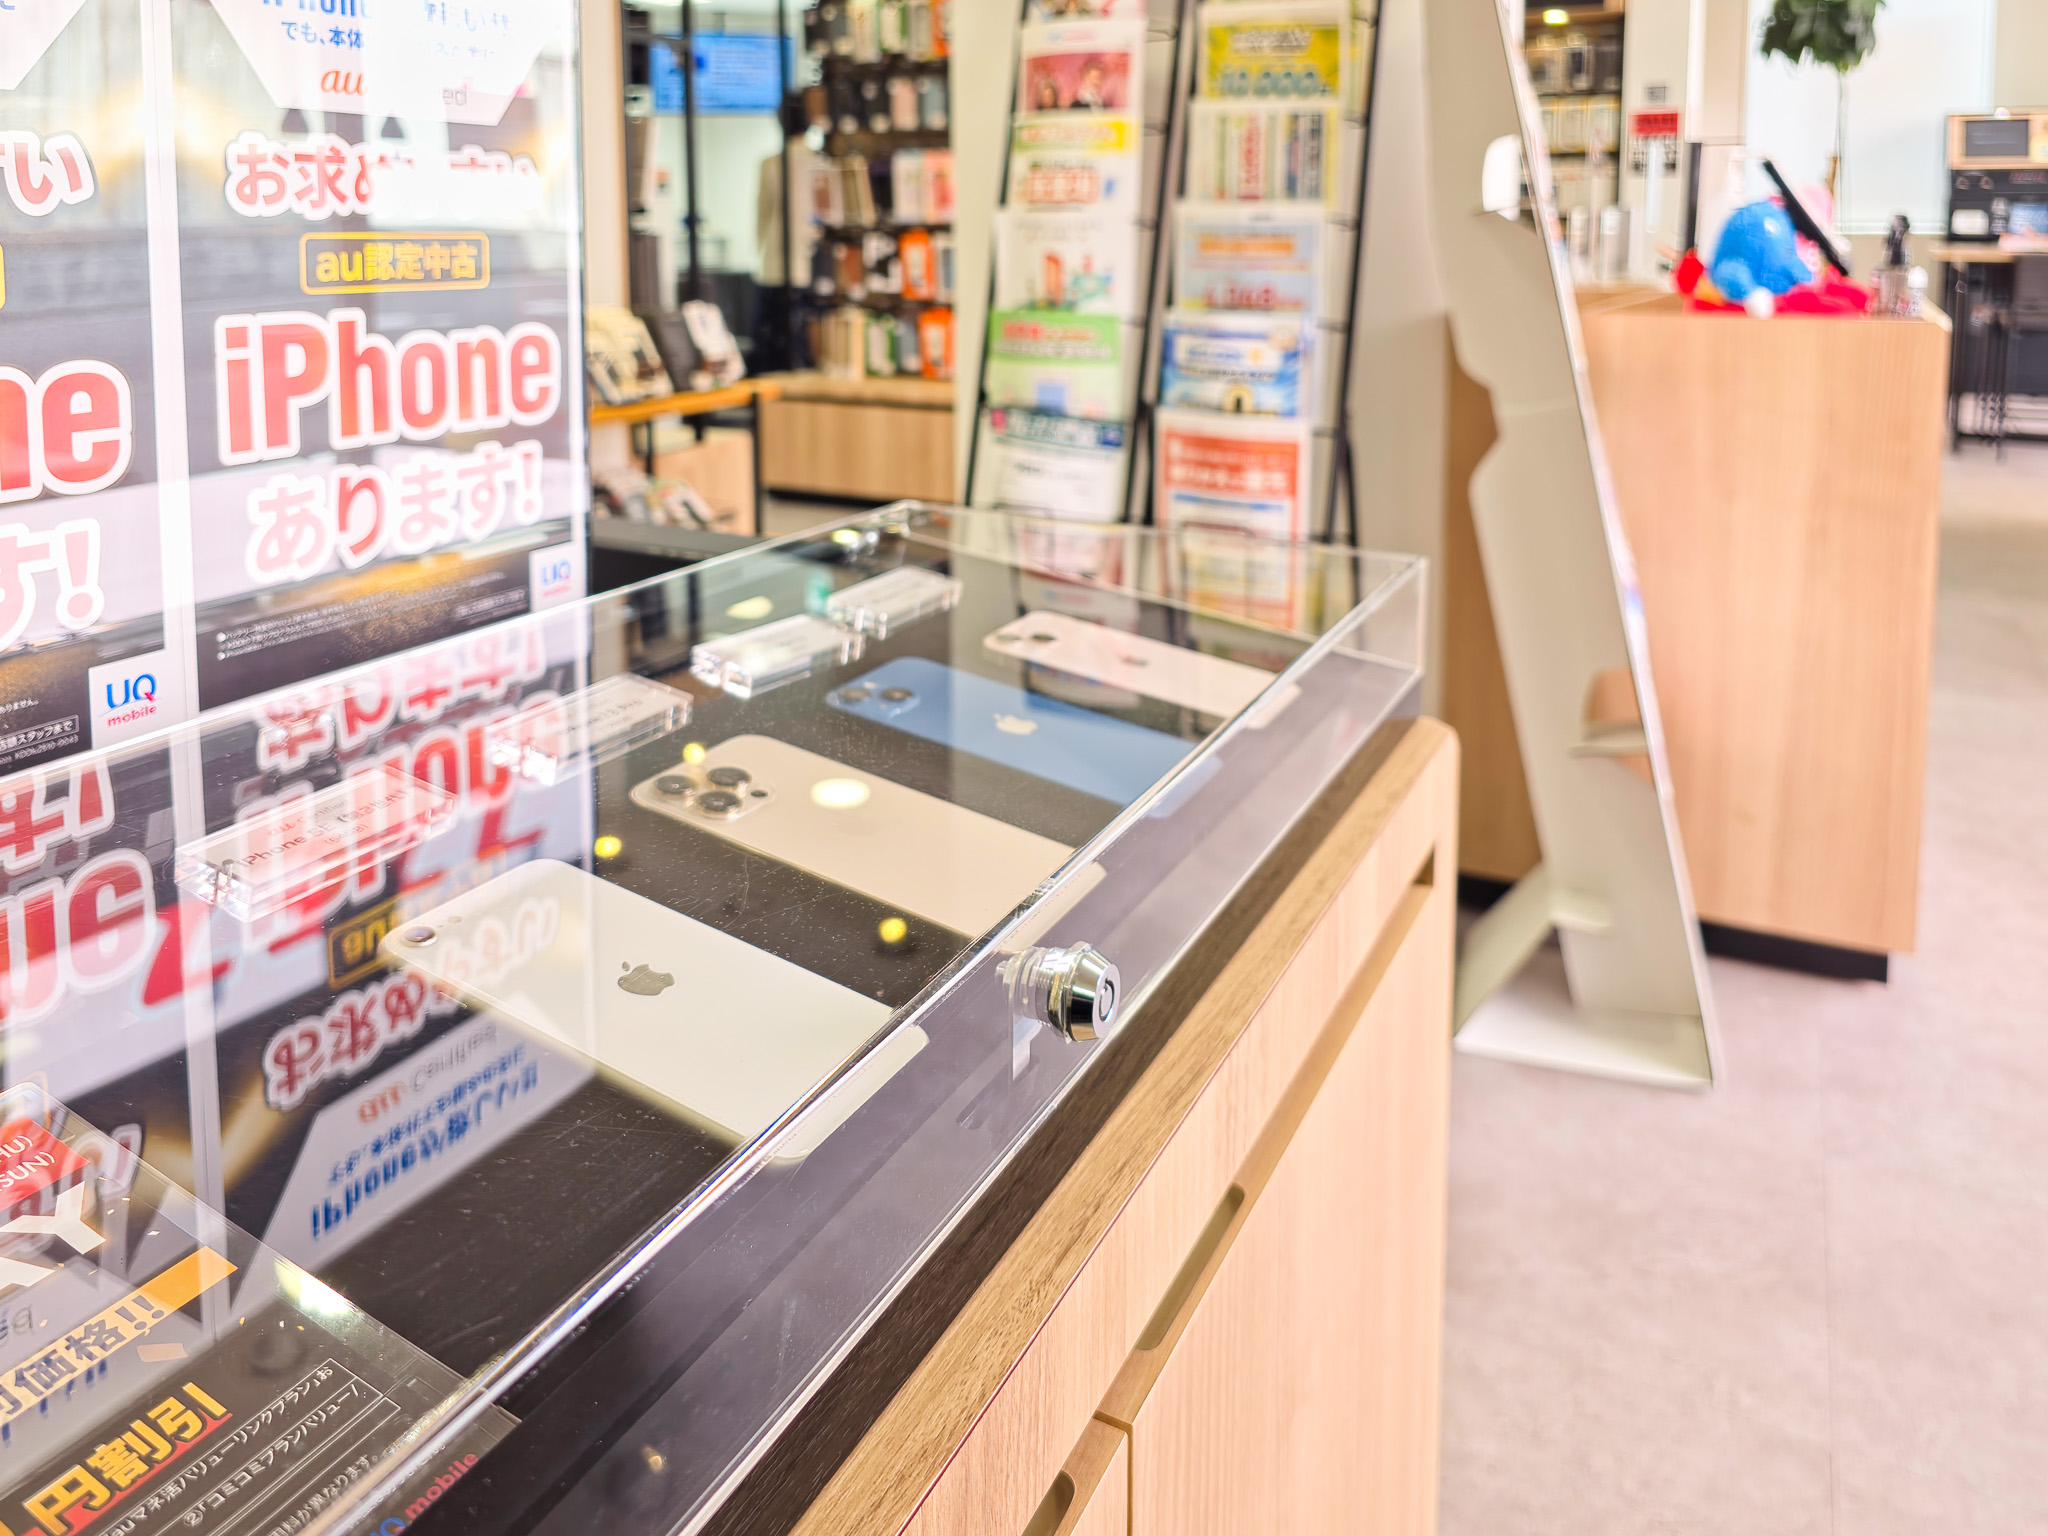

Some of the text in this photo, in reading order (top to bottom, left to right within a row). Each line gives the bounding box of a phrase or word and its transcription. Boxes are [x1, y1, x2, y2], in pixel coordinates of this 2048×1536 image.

[320, 69, 366, 96] au
[316, 241, 478, 283] au認定中古
[224, 319, 554, 456] iPhone
[256, 452, 544, 574] あります!
[106, 673, 158, 710] UQ
[107, 705, 158, 728] mobile
[0, 1381, 228, 1536] 円割引
[405, 1452, 479, 1522] mobile
